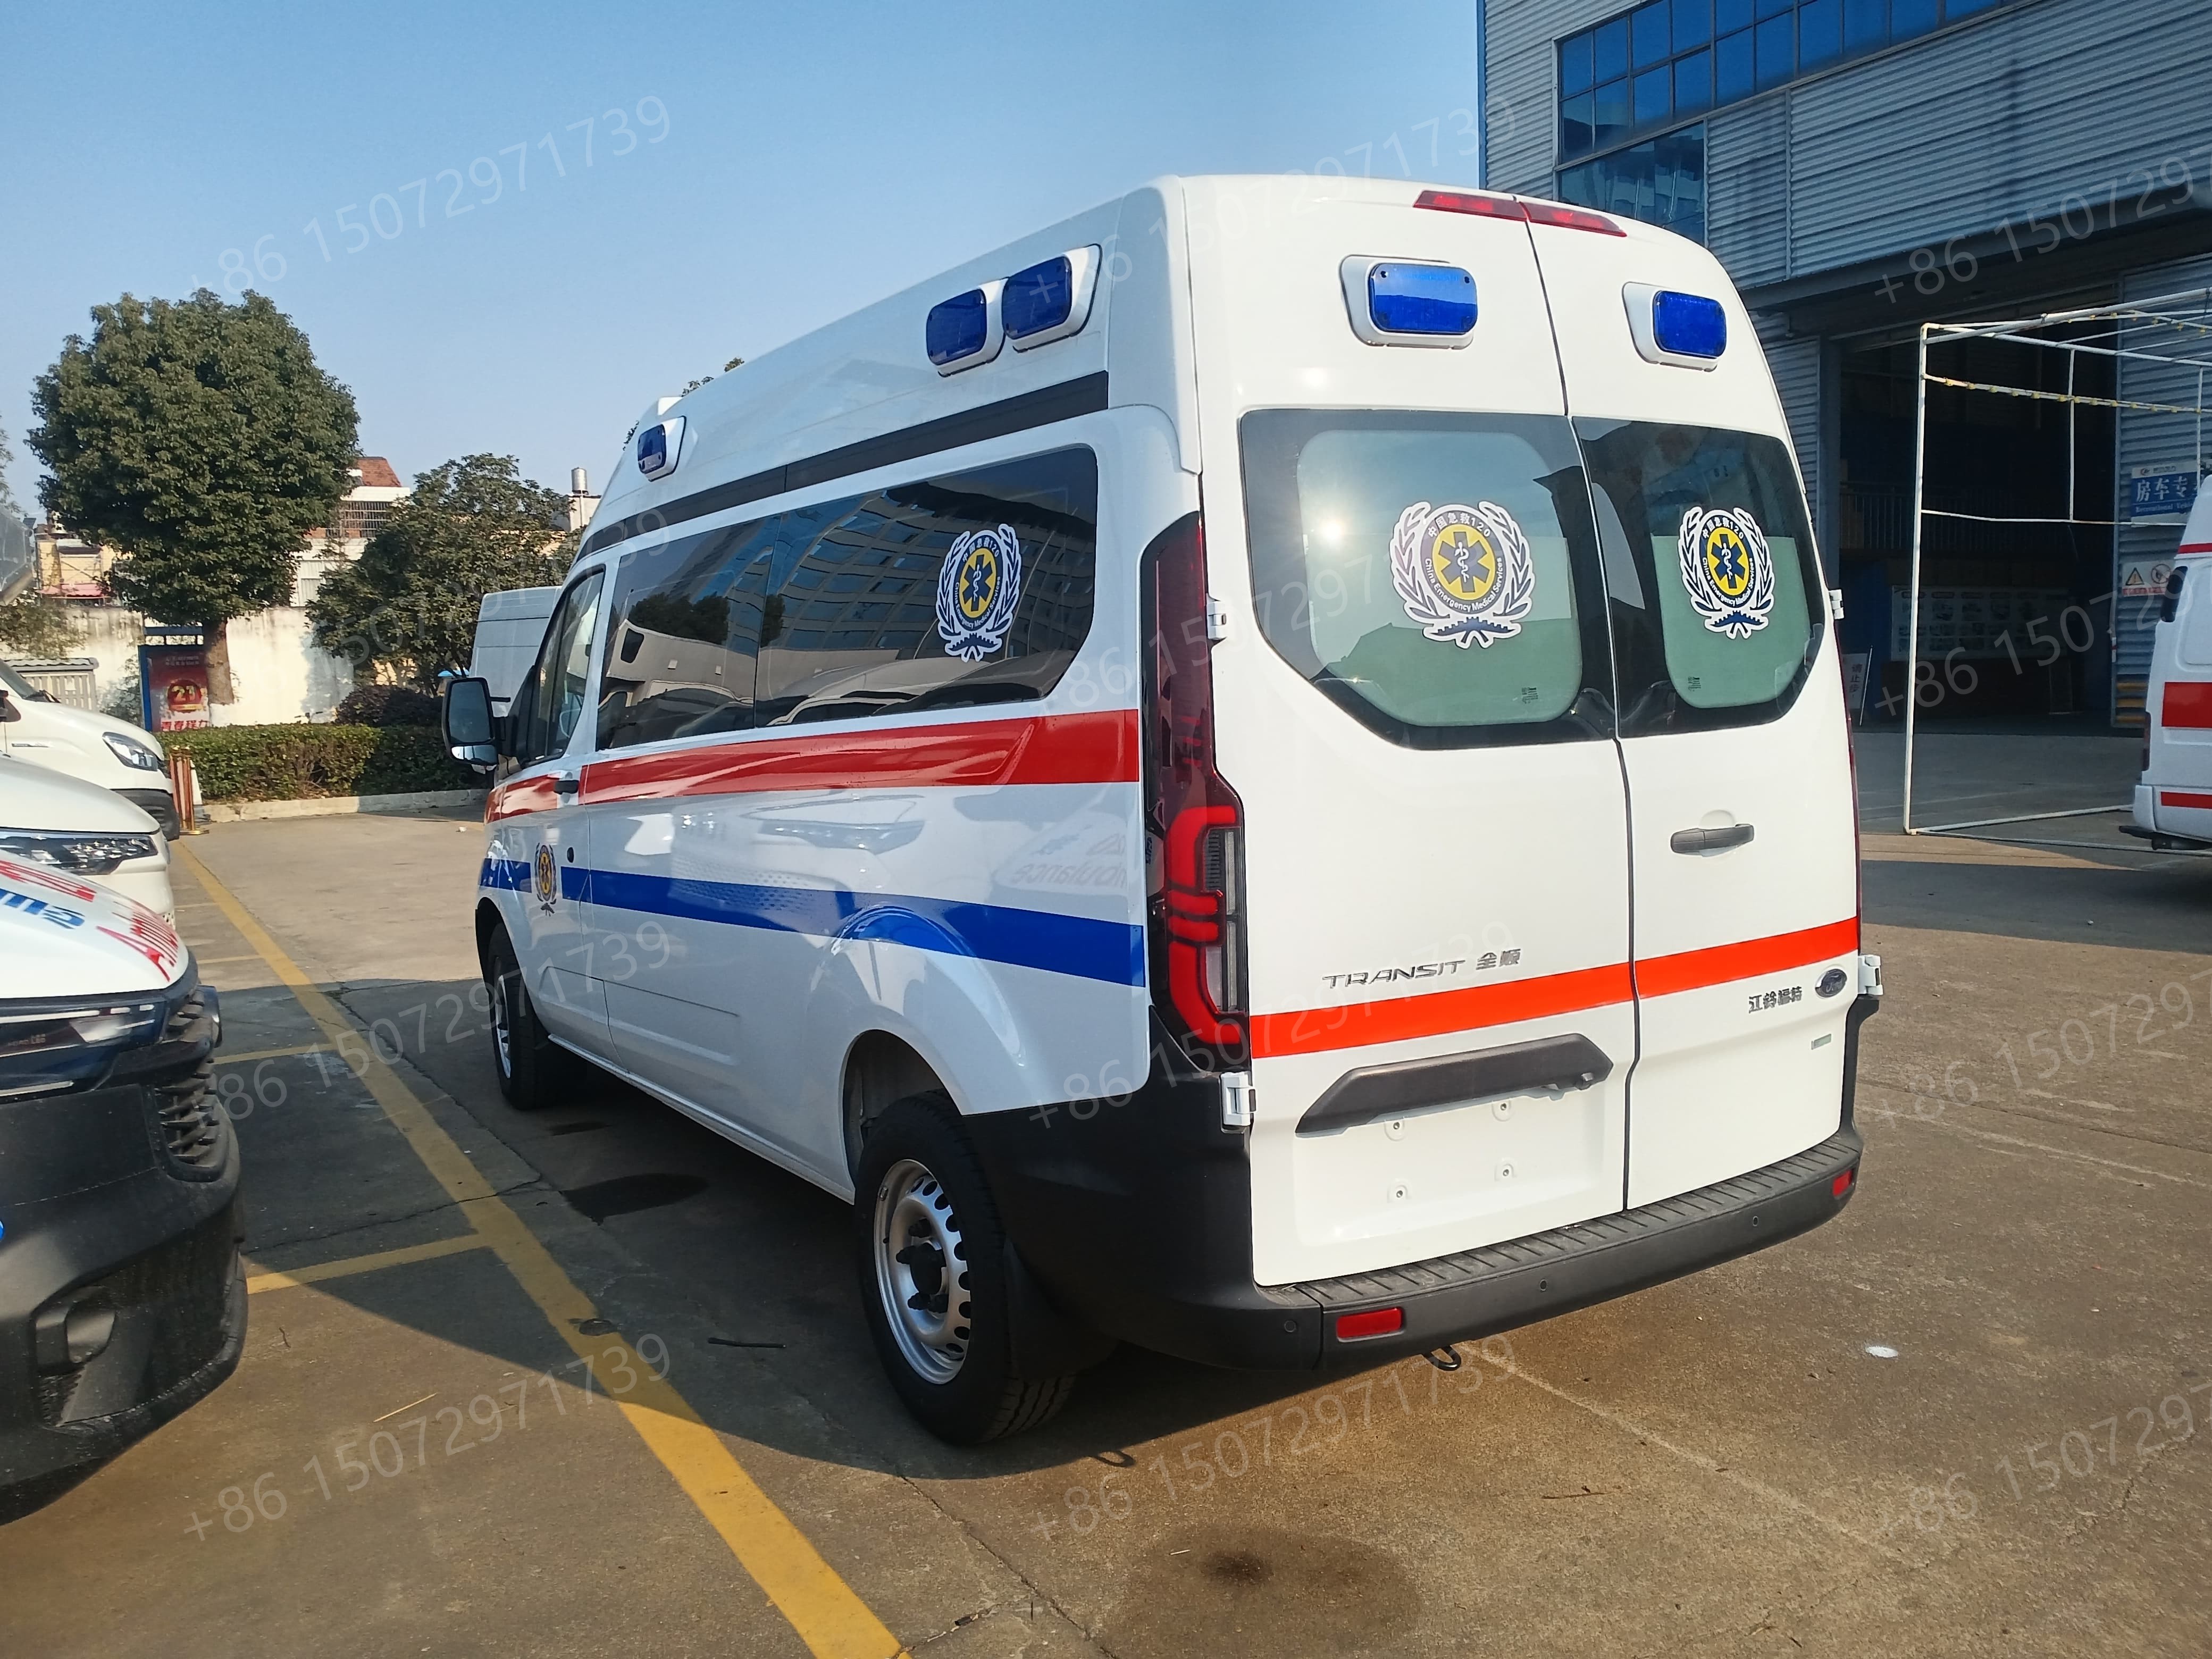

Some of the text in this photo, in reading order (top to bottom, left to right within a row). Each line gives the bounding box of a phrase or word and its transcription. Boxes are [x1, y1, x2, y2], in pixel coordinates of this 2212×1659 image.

[1428, 512, 1491, 538] 中国急救120
[1425, 557, 1503, 612] China Emergency Medical Services
[1702, 557, 1711, 580] China
[1710, 579, 1736, 607] Emergency
[1735, 588, 1751, 605] Medical
[1322, 960, 1465, 989] TRANSIT
[1748, 986, 1803, 1014] 江铃福特
